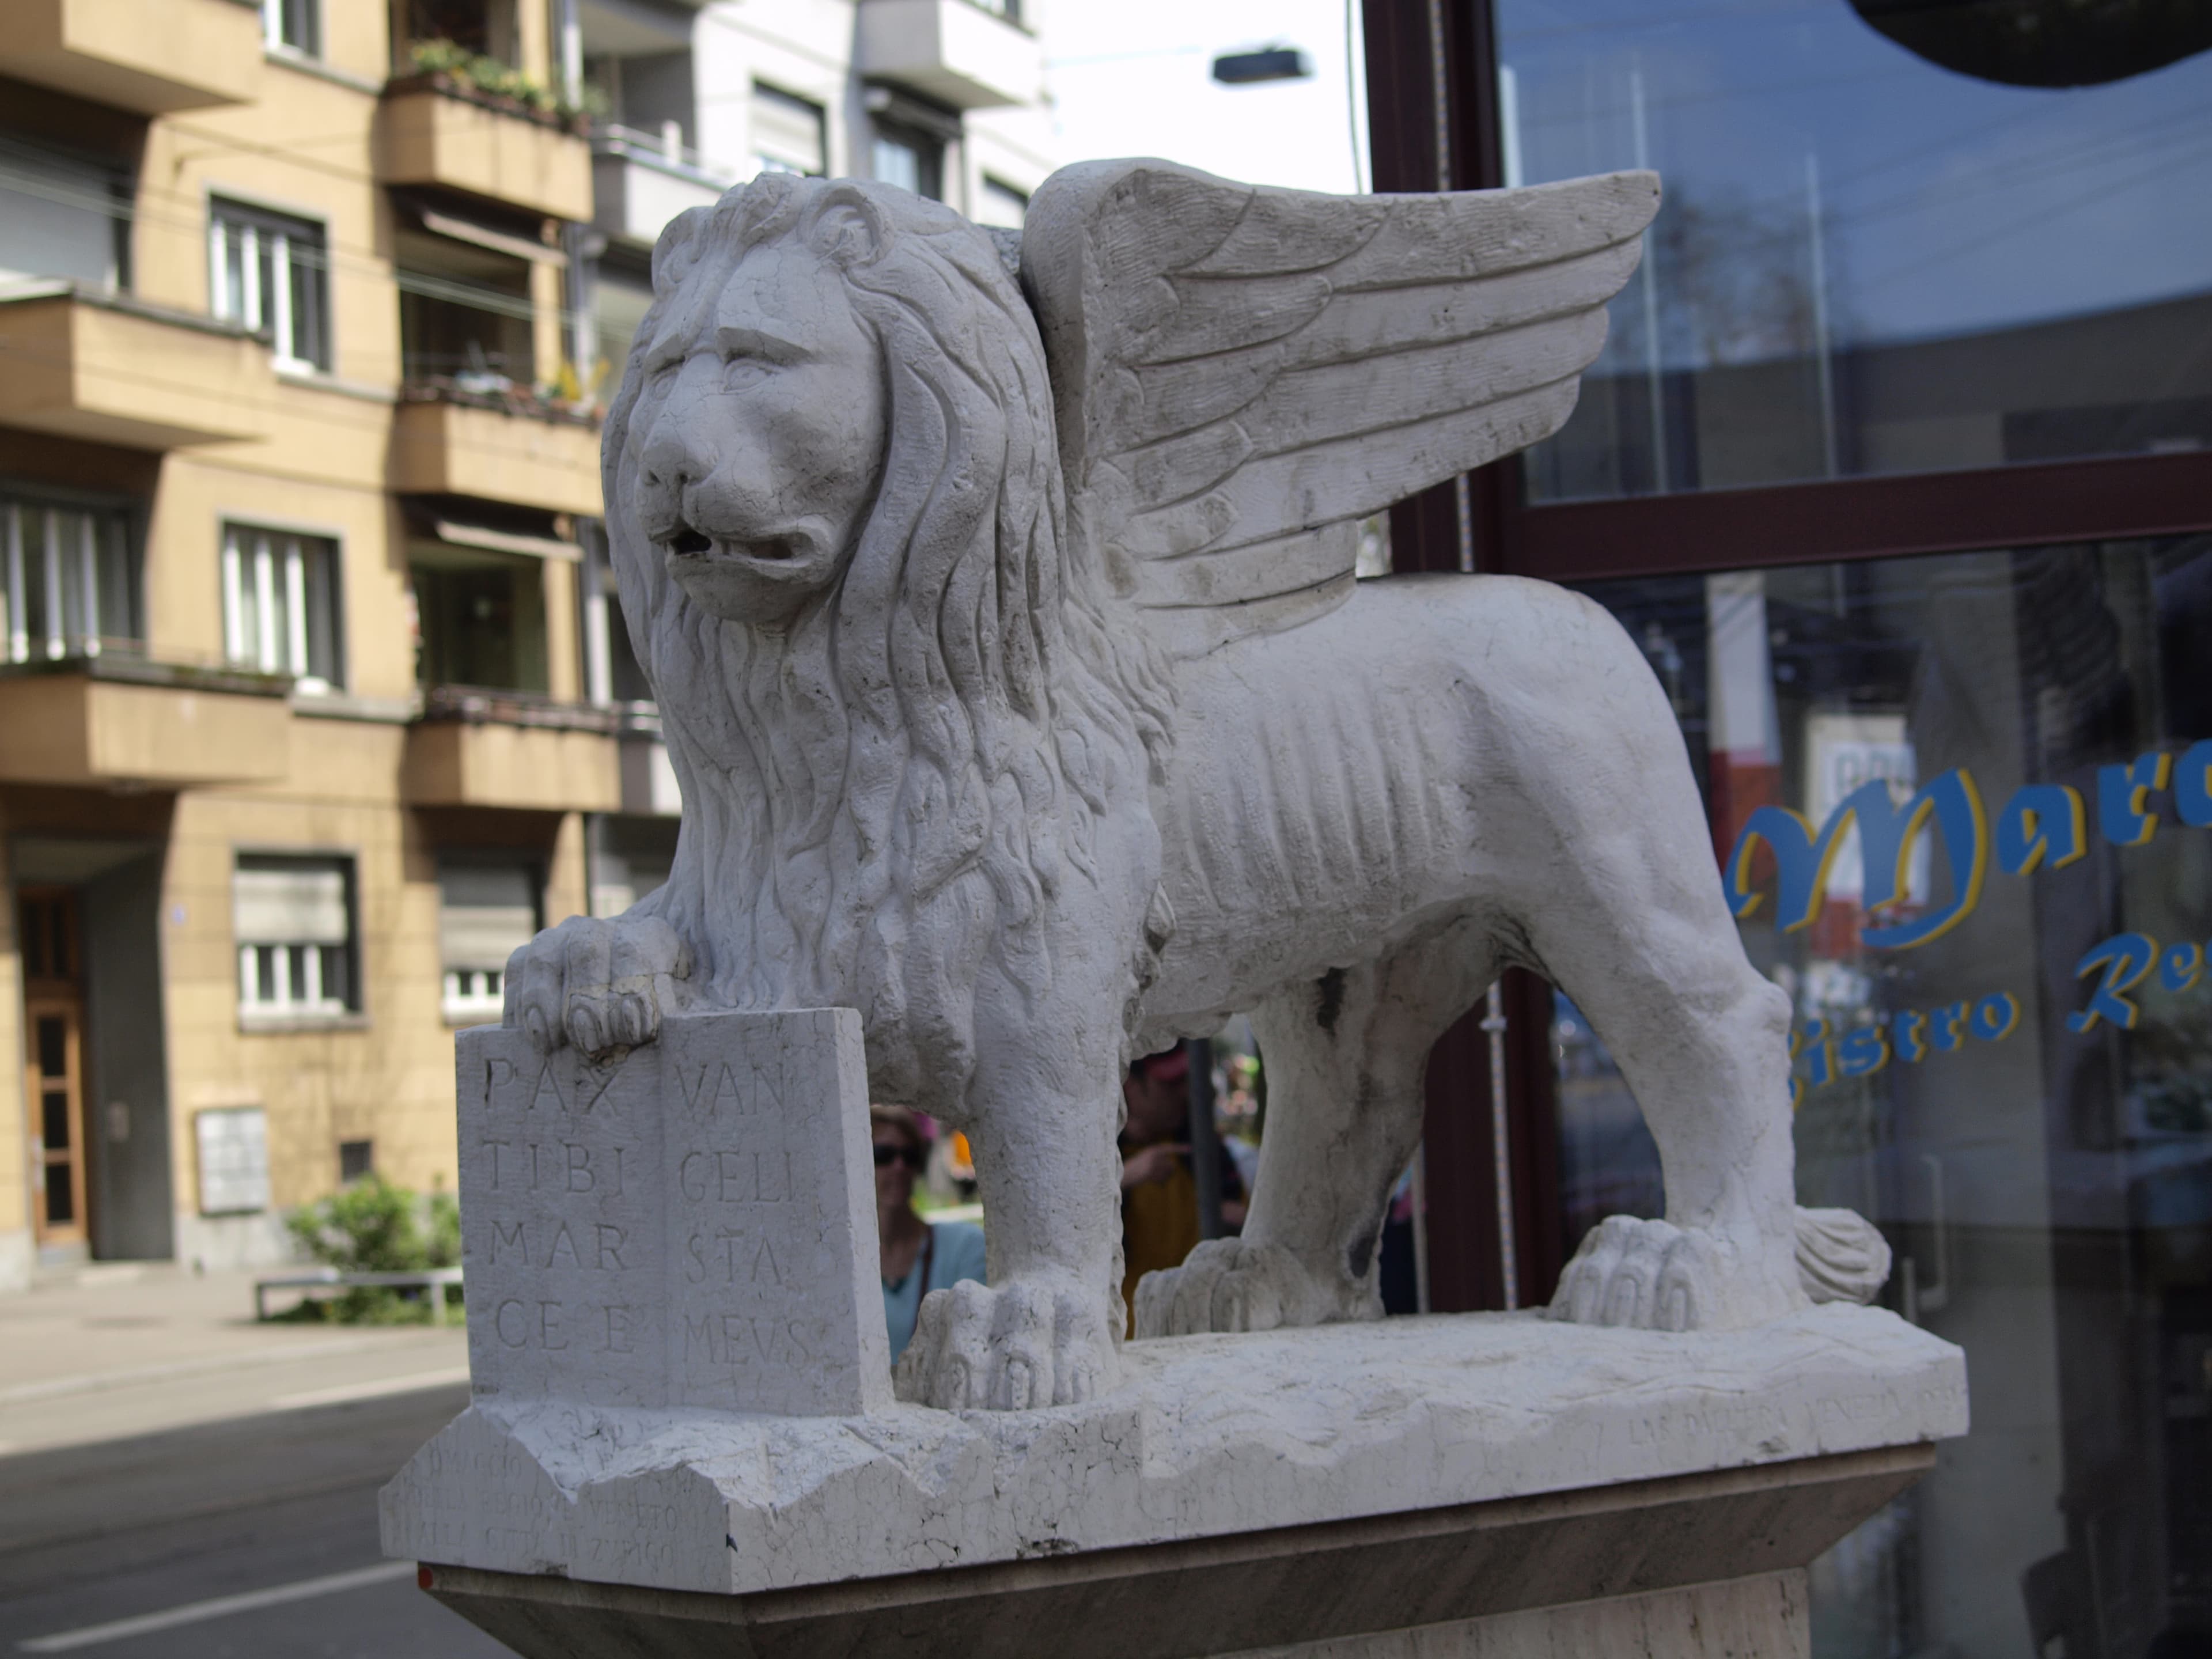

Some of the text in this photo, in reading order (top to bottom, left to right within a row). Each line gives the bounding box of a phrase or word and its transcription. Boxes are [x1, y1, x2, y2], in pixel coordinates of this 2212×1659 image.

[1788, 932, 2212, 1111] istro Re
[484, 1057, 620, 1117] PAX
[674, 1063, 787, 1116] VAN
[482, 1138, 625, 1198] TIBI
[680, 1150, 794, 1203] GELI
[488, 1220, 629, 1270] MAR
[687, 1228, 784, 1285] STA
[495, 1298, 635, 1354] CE E
[683, 1314, 810, 1368] MEVS
[590, 1499, 677, 1531] VENETO
